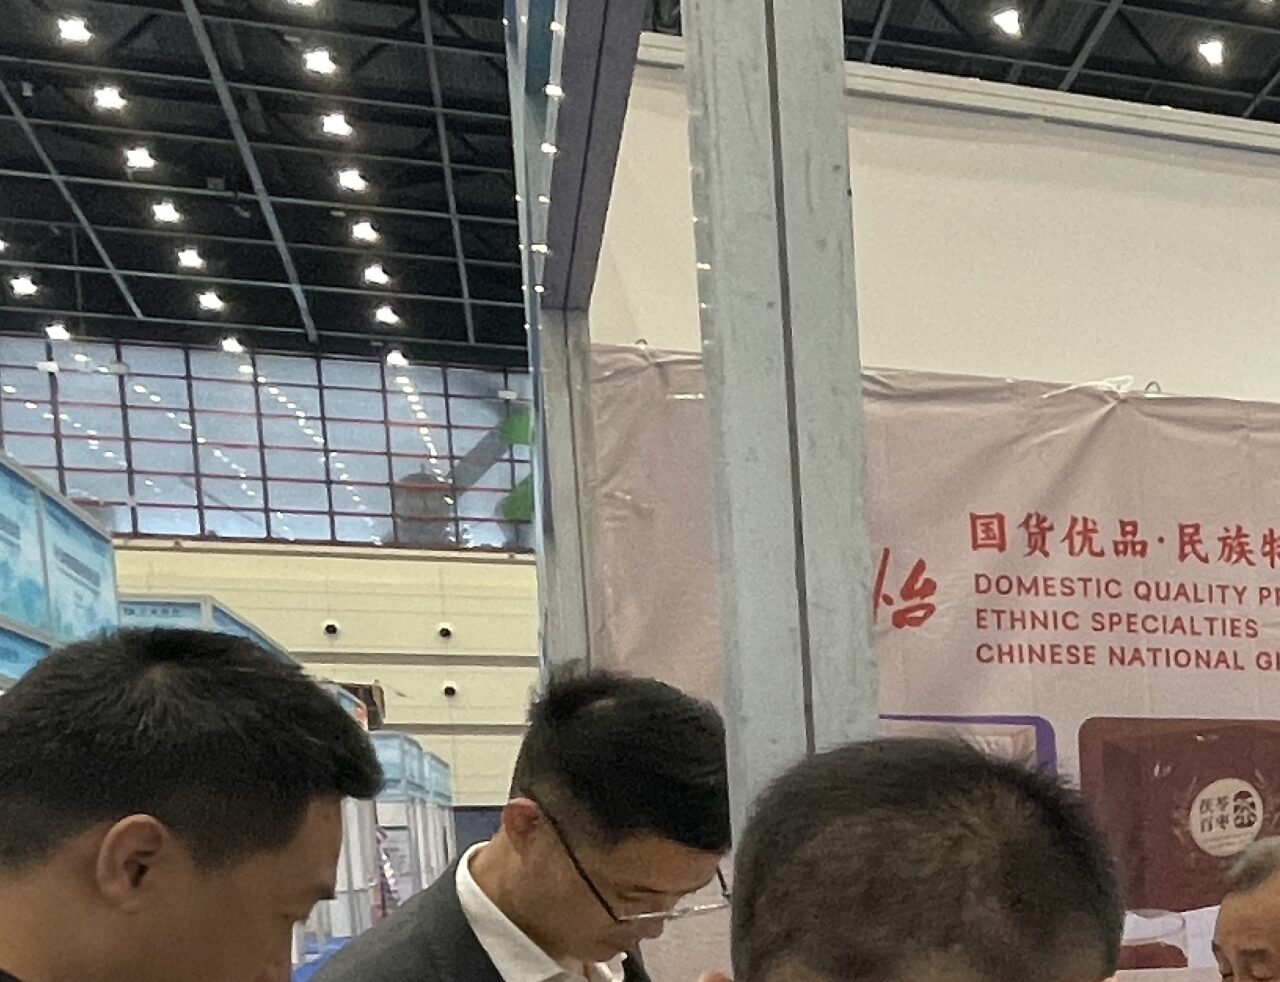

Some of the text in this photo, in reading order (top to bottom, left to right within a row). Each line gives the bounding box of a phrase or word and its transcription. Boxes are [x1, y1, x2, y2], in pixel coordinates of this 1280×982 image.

[974, 573, 1123, 600] DOMESTIC
[1133, 579, 1248, 606] QUALITY
[975, 608, 1260, 639] ETHNIC SPECIALTIES
[976, 642, 1096, 666] CHINESE
[1108, 645, 1246, 671] NATIONAL
